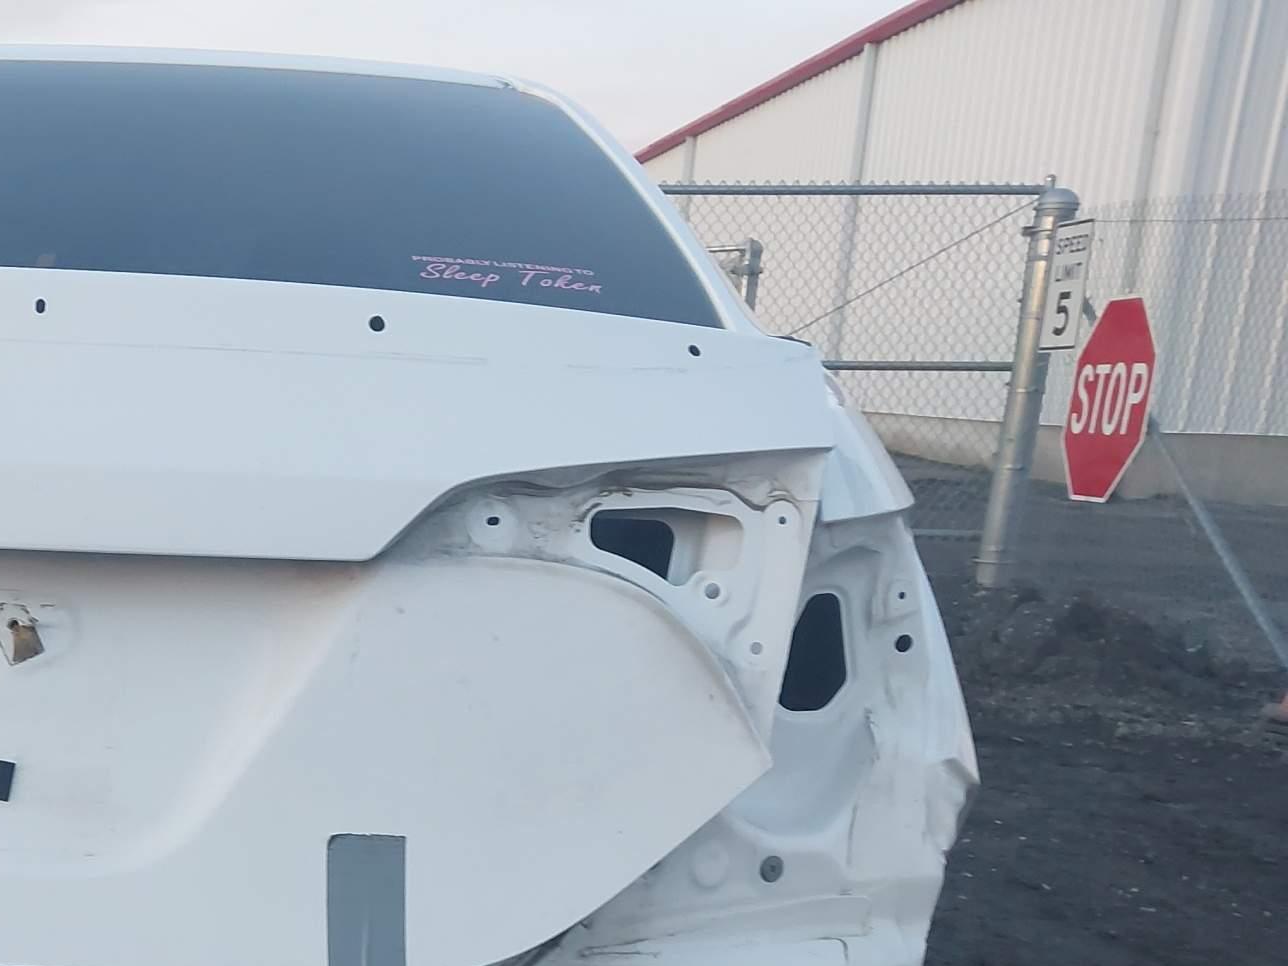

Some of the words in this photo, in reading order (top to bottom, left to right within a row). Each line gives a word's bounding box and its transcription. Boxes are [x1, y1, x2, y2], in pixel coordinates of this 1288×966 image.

[1055, 234, 1089, 255] SPEED
[420, 263, 500, 288] Sleep
[518, 270, 602, 294] Token
[1054, 262, 1083, 282] LIMIT
[1052, 291, 1072, 336] 5
[1070, 361, 1149, 436] STOP
